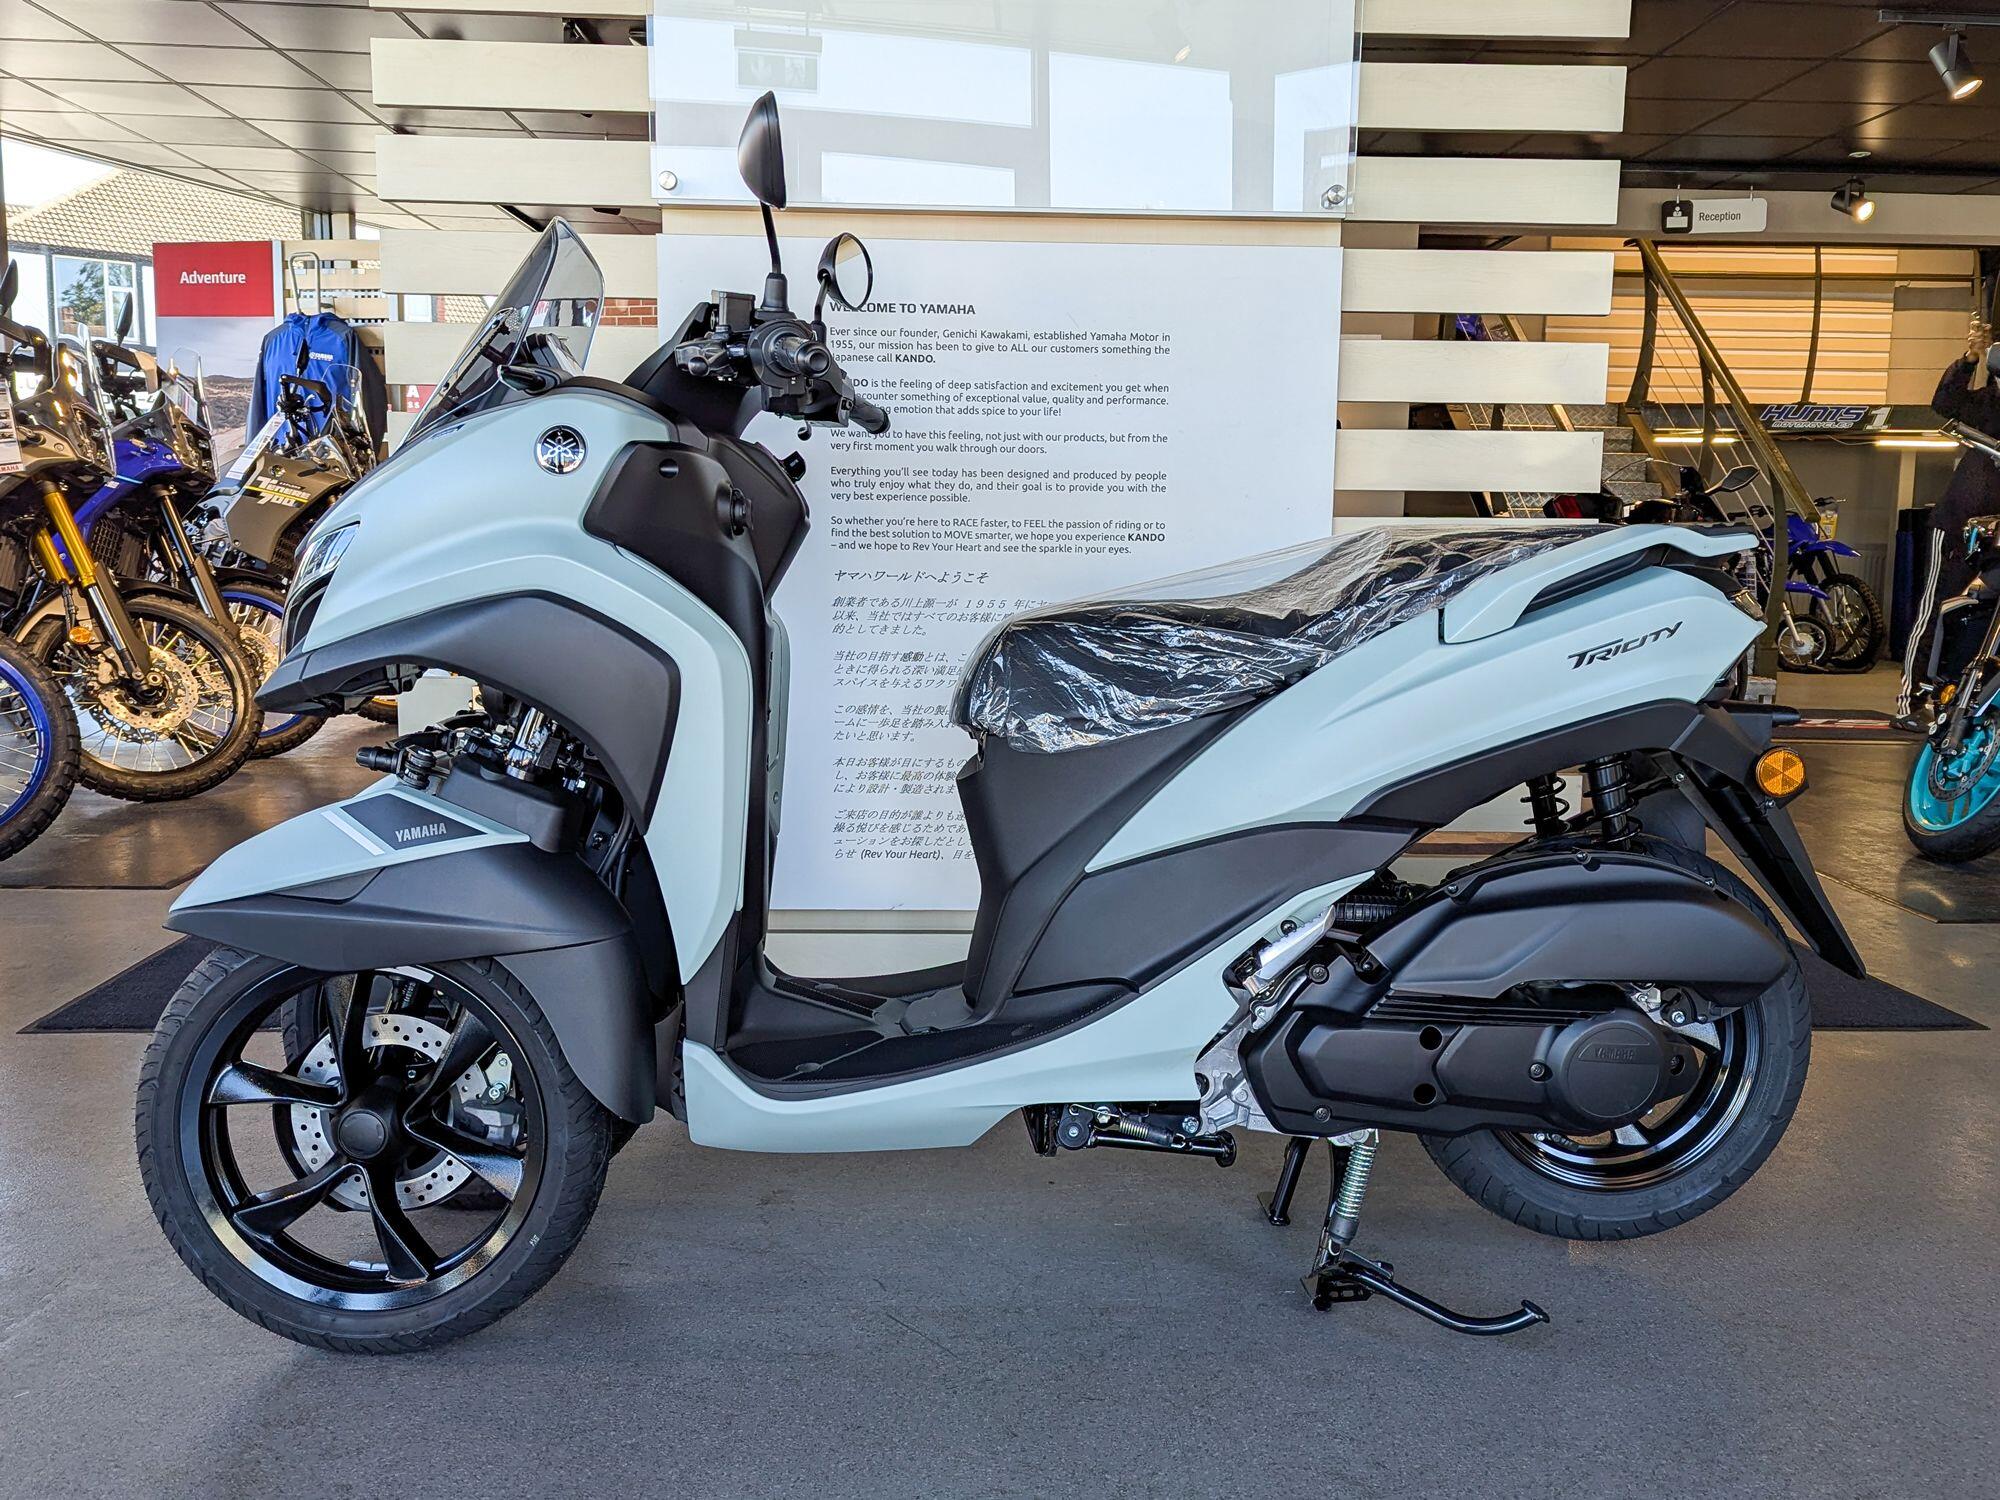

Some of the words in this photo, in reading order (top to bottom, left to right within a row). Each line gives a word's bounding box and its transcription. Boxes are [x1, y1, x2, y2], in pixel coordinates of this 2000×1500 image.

[1698, 210, 1742, 222] Reception
[180, 270, 247, 284] Adventure
[899, 303, 916, 314] TO
[919, 303, 976, 315] YAMAHA
[829, 326, 850, 337] Ever
[853, 326, 877, 337] since
[880, 329, 896, 337] our
[899, 327, 939, 340] founder,
[942, 328, 977, 339] Genichi
[980, 328, 1030, 342] Kawakami,
[1033, 329, 1087, 341] established
[1090, 330, 1126, 341] Yamaha
[1129, 331, 1159, 342] Motor
[1162, 331, 1170, 342] in
[830, 339, 856, 351] 1955,
[858, 341, 875, 350] our
[877, 339, 913, 350] mission
[916, 340, 933, 351] has
[935, 340, 959, 351] been
[961, 342, 972, 351] to
[974, 341, 994, 354] give
[997, 343, 1008, 352] to
[1010, 342, 1028, 352] ALL
[1030, 344, 1047, 353] our
[1049, 343, 1099, 354] customers
[1101, 343, 1151, 357] something
[1154, 344, 1170, 355] the
[876, 351, 893, 362] call
[894, 352, 936, 363] KANDO.
[870, 377, 879, 388] is
[880, 377, 897, 388] the
[899, 378, 932, 391] feeling
[934, 378, 946, 389] of
[947, 379, 972, 391] deep
[973, 379, 1028, 390] satisfaction
[1030, 380, 1048, 391] and
[1050, 380, 1103, 392] excitement
[1105, 384, 1123, 394] you
[1125, 383, 1141, 394] get
[1143, 382, 1169, 393] when
[900, 390, 950, 404] something
[952, 391, 963, 402] of
[965, 392, 1020, 405] exceptional
[1021, 393, 1049, 405] value,
[1051, 393, 1084, 406] quality
[1086, 394, 1104, 404] and
[1106, 394, 1168, 407] performance.
[893, 403, 933, 414] emotion
[935, 404, 955, 415] that
[956, 404, 979, 415] adds
[981, 405, 1005, 418] spice
[1007, 406, 1018, 416] to
[1019, 408, 1041, 418] your
[1043, 406, 1061, 417] life!
[1759, 404, 1869, 422] HUNTS
[830, 427, 846, 438] We
[892, 430, 903, 439] to
[904, 429, 927, 439] have
[928, 429, 946, 440] this
[948, 429, 983, 442] feeling,
[985, 431, 1002, 441] not
[1003, 430, 1021, 443] just
[1022, 430, 1043, 441] with
[1045, 433, 1061, 441] our
[1063, 431, 1107, 444] products,
[1109, 432, 1125, 442] but
[1127, 432, 1150, 443] from
[1152, 432, 1168, 443] the
[830, 442, 851, 452] very
[852, 440, 873, 451] first
[874, 441, 914, 451] moment
[916, 443, 933, 454] you
[935, 441, 957, 452] walk
[959, 442, 997, 455] through
[999, 445, 1016, 453] our
[1017, 443, 1047, 454] doors.
[830, 465, 880, 478] Everything
[883, 466, 909, 479] you'll
[912, 469, 928, 477] see
[931, 466, 958, 479] today
[961, 467, 977, 478] has
[980, 467, 1003, 478] been
[1007, 468, 1049, 481] designed
[1052, 468, 1069, 479] and
[1073, 469, 1117, 482] produced
[1120, 469, 1131, 482] by
[1134, 470, 1166, 483] people
[830, 492, 851, 503] very
[853, 490, 874, 501] best
[875, 491, 927, 504] experience
[929, 491, 970, 504] possible.
[830, 515, 842, 525] So
[844, 515, 884, 526] whether
[885, 515, 915, 528] you're
[917, 516, 938, 527] here
[940, 517, 951, 527] to
[952, 516, 978, 527] RACE
[980, 517, 1009, 530] faster,
[1011, 518, 1022, 528] to
[1023, 517, 1046, 528] FEEL
[1048, 518, 1063, 528] the
[1065, 518, 1100, 531] passion
[1102, 519, 1112, 529] of
[1114, 519, 1141, 531] riding
[1143, 522, 1153, 530] or
[1155, 520, 1165, 530] to
[831, 527, 849, 538] find
[851, 527, 867, 538] the
[869, 528, 890, 538] best
[891, 528, 929, 539] solution
[931, 530, 942, 539] to
[943, 529, 973, 539] MOVE
[974, 530, 1012, 542] smarter,
[1014, 532, 1028, 540] we
[1030, 530, 1054, 543] hope
[1055, 533, 1073, 543] you
[1074, 530, 1125, 544] experience
[1127, 531, 1165, 542] KANDO
[834, 569, 990, 584] ヤマハワールドへようこそ
[1567, 620, 1684, 670] TRICITY
[394, 822, 447, 843] YAMAHA
[861, 848, 882, 860] (Rev
[885, 849, 907, 859] Your
